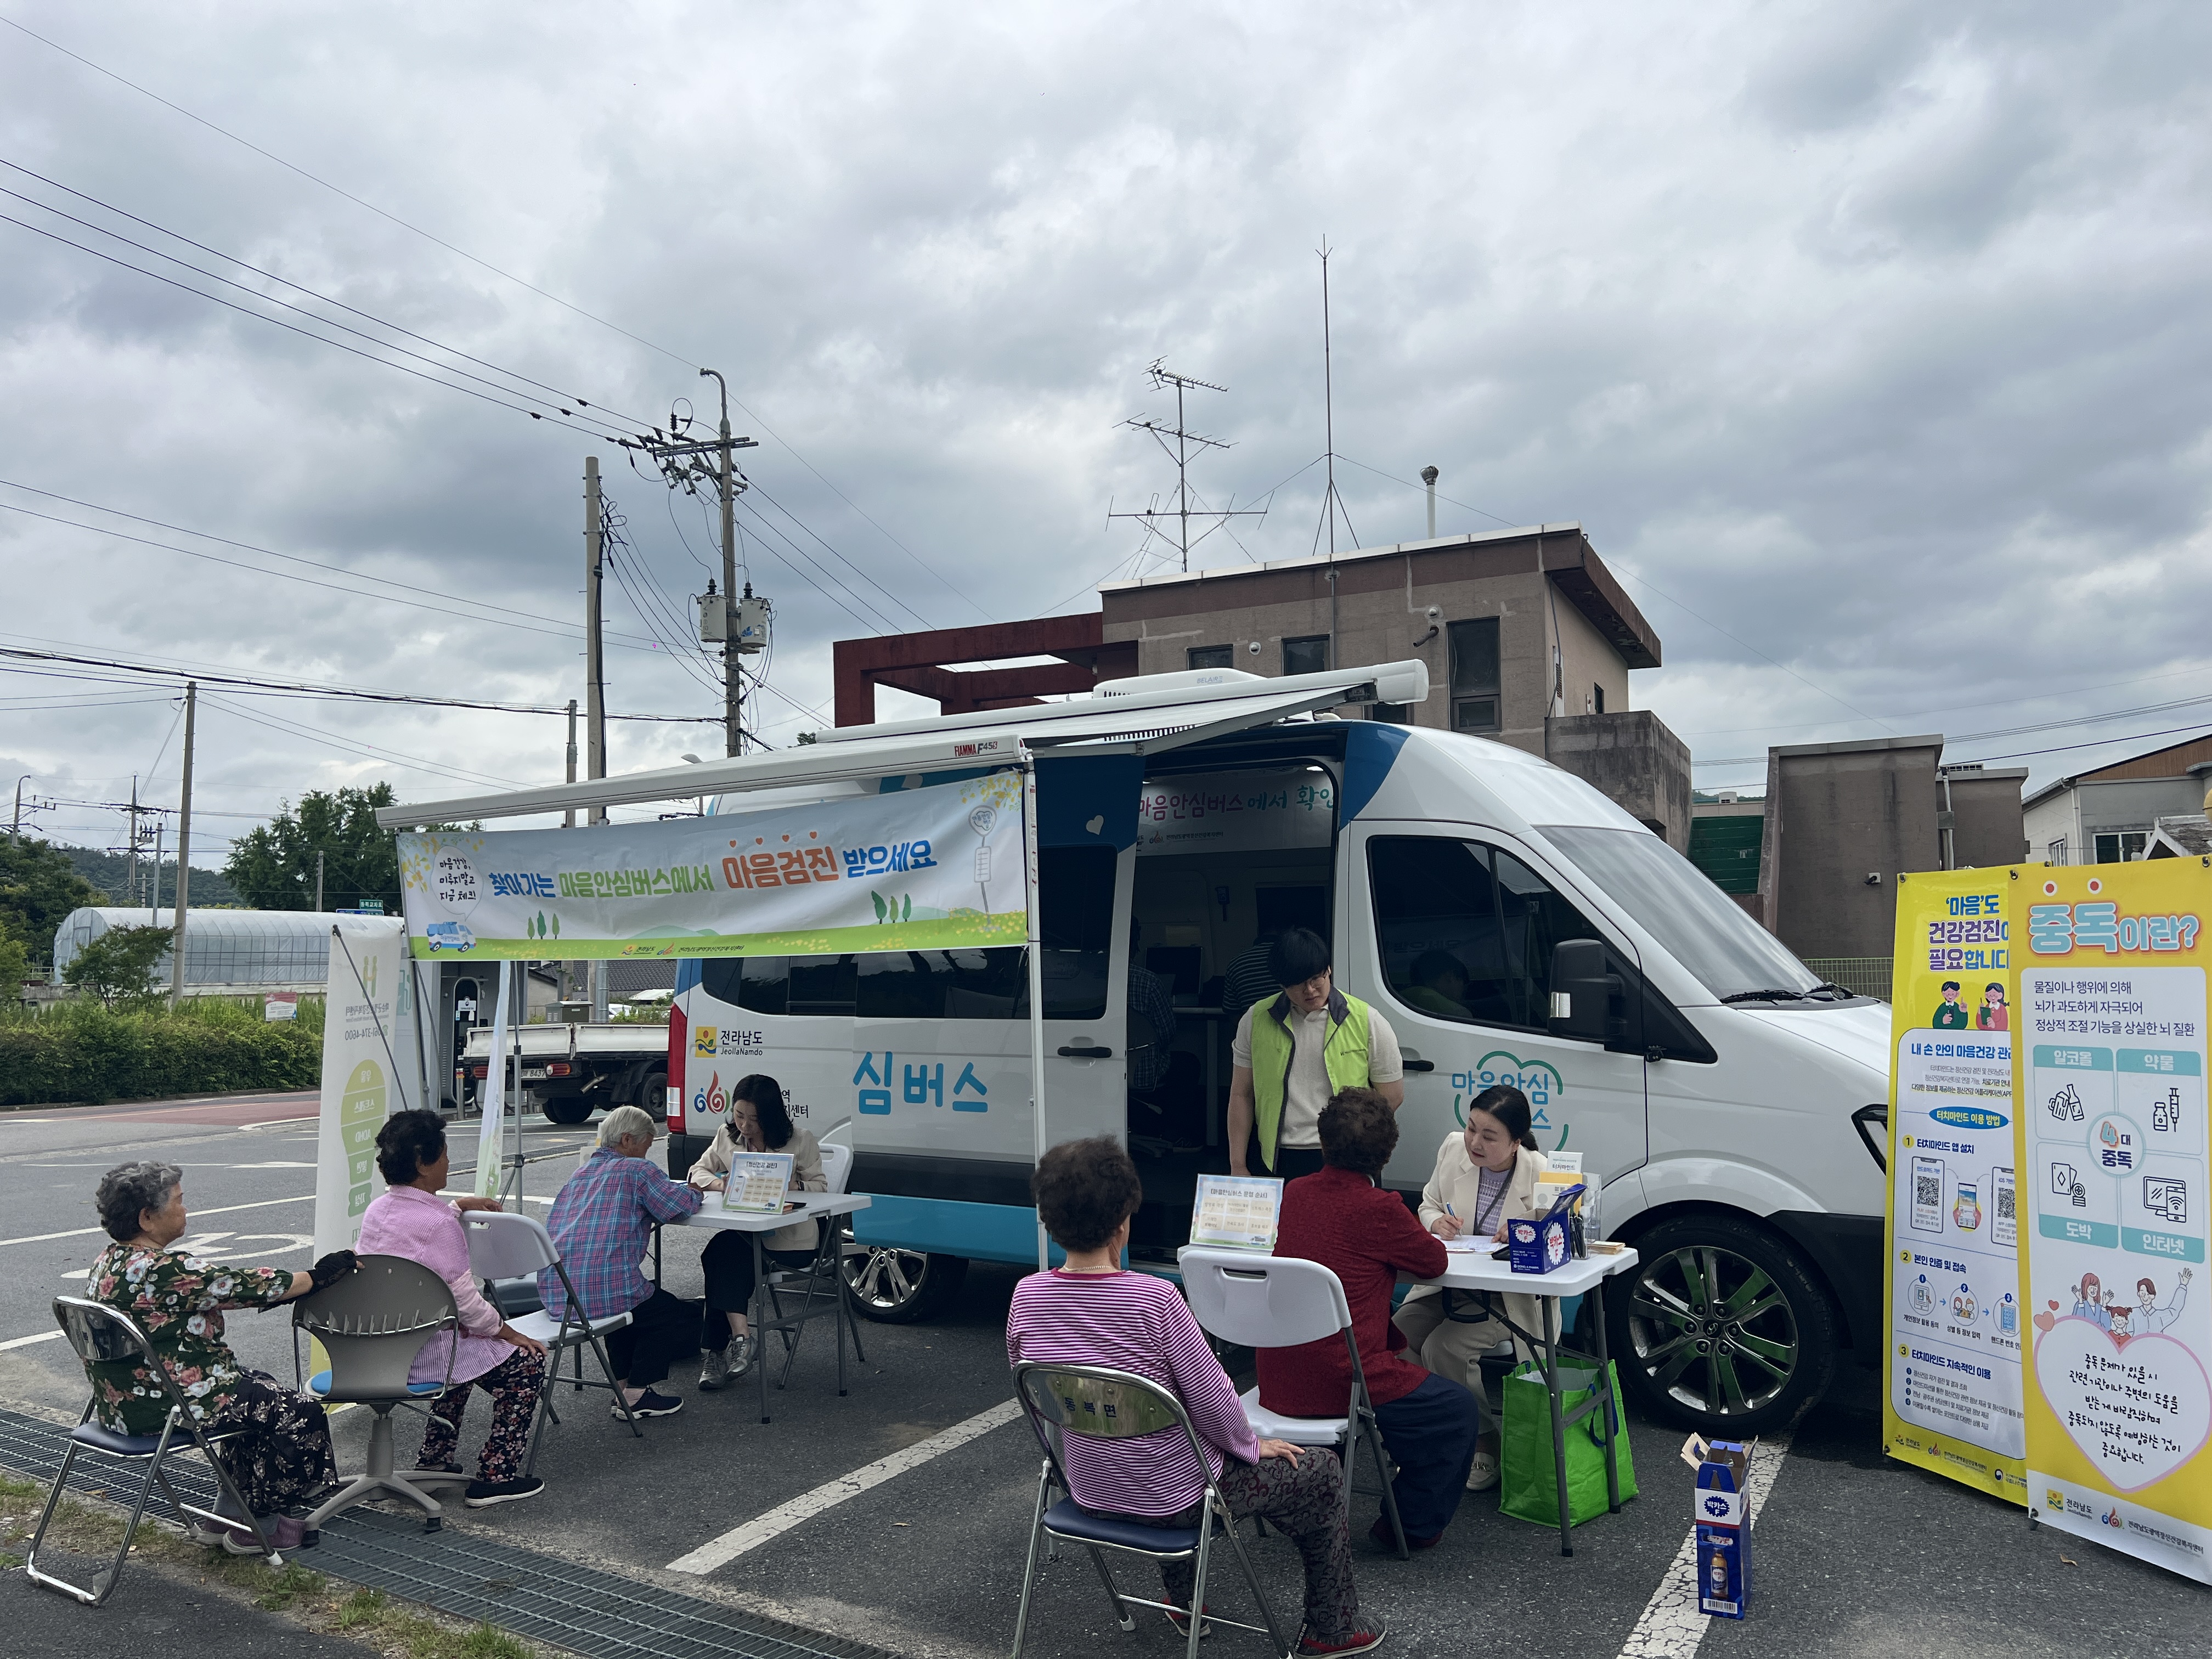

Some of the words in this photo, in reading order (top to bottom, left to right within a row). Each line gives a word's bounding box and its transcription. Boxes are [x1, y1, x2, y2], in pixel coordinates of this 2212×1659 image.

[955, 744, 977, 757] FIAMMA
[439, 857, 471, 870] 마음건강,
[488, 872, 556, 898] 찾아가는
[558, 865, 715, 898] 마음안심버스에서
[722, 846, 839, 889] 마음검진
[843, 840, 938, 878] 받으세요
[440, 889, 455, 901] 지금
[2029, 902, 2199, 953] 중독이란?
[2034, 981, 2075, 994] 물질이나
[2076, 981, 2108, 994] 행위에
[2110, 981, 2132, 995] 의해
[2035, 1000, 2055, 1012] 뇌가
[2057, 1000, 2098, 1014] 과도하게
[2100, 1001, 2143, 1015] 자극되어
[2035, 1019, 2066, 1032] 정상적
[2068, 1020, 2089, 1033] 조절
[2090, 1020, 2123, 1035] 기능을
[2124, 1022, 2157, 1035] 상실한
[2159, 1023, 2170, 1036] 뇌
[2173, 1023, 2195, 1037] 질환
[720, 1030, 763, 1046] 전라남도
[720, 1047, 763, 1056] JeollaNamdo
[1911, 1043, 1921, 1055] 내
[1923, 1043, 1933, 1056] 손
[1936, 1044, 1954, 1057] 안의
[1957, 1045, 1995, 1059] 마음건강
[2053, 1050, 2093, 1067] 알코올
[2144, 1054, 2174, 1071] 약물
[1925, 1075, 1961, 1084] 정신건강복지센터로
[1961, 1076, 1970, 1085] 연결
[1937, 1110, 1969, 1122] 터치마인드
[1971, 1114, 1984, 1125] 이용
[1986, 1115, 2000, 1126] 방법
[1917, 1138, 1950, 1151] 터치마인드
[1952, 1143, 1959, 1152] 앱
[1960, 1144, 1974, 1154] 설치
[2102, 1149, 2132, 1169] 중독
[2066, 1222, 2092, 1240] 도박
[1550, 1234, 1562, 1249] 박카스
[2142, 1234, 2185, 1255] 인터넷
[1555, 1249, 1558, 1260] F
[1903, 1252, 1908, 1261] 2
[1914, 1254, 1928, 1265] 본인
[1929, 1257, 1943, 1268] 인증
[1944, 1260, 1951, 1271] 및
[1953, 1262, 1966, 1273] 접속
[1903, 1314, 1920, 1324] 개인정보
[1921, 1318, 1929, 1327] 활용
[1947, 1325, 1955, 1333] 성별
[1962, 1329, 1971, 1337] 정보
[1972, 1331, 1980, 1340] 입력
[1991, 1336, 2004, 1346] 핸드폰
[1901, 1346, 1906, 1355] 3
[1912, 1349, 1945, 1367] 터치마인드
[1946, 1359, 1975, 1375] 지속적인
[1977, 1367, 1991, 1380] 이용
[2085, 1353, 2098, 1369] 중독
[2100, 1357, 2126, 1372] 문제가
[2128, 1366, 2145, 1384] 있을
[1913, 1370, 1928, 1380] 정신건강
[1937, 1376, 1945, 1385] 검진
[1951, 1380, 1959, 1389] 결과
[1959, 1383, 1967, 1391] 조회
[1912, 1380, 1935, 1392] 마인드미션을
[1944, 1389, 1960, 1400] 정신건강
[1961, 1394, 1969, 1403] 관련
[1978, 1400, 1987, 1408] 제공
[1993, 1403, 2008, 1414] 정신건강
[2069, 1370, 2087, 1386] 관련
[2089, 1378, 2123, 1391] 기관이나
[2125, 1386, 2152, 1401] 주변의
[2154, 1393, 2178, 1415] 도움을
[1935, 1397, 1950, 1407] 상담센터
[1956, 1403, 1971, 1414] 치료기관
[1972, 1408, 1980, 1417] 정보
[1981, 1411, 1989, 1419] 제공
[2085, 1396, 2100, 1410] 받는
[2113, 1405, 2160, 1424] 바람직하며
[1944, 1410, 1959, 1420] 포인트로
[1960, 1415, 1972, 1425] 다양한
[1973, 1419, 1980, 1427] 상품
[1981, 1422, 1989, 1430] 지급
[2068, 1411, 2098, 1429] 중독되지
[2100, 1421, 2121, 1440] 않도록
[2124, 1431, 2159, 1449] 예방하는
[2161, 1438, 2181, 1452] 것이
[1906, 1437, 1920, 1447] 전라남도
[2102, 1442, 2144, 1465] 중요합니다.
[1707, 1500, 1727, 1510] 박카스
[2066, 1498, 2092, 1514] 전라남도
[2128, 1520, 2204, 1554] 전라남도광역정신건강복지센터
